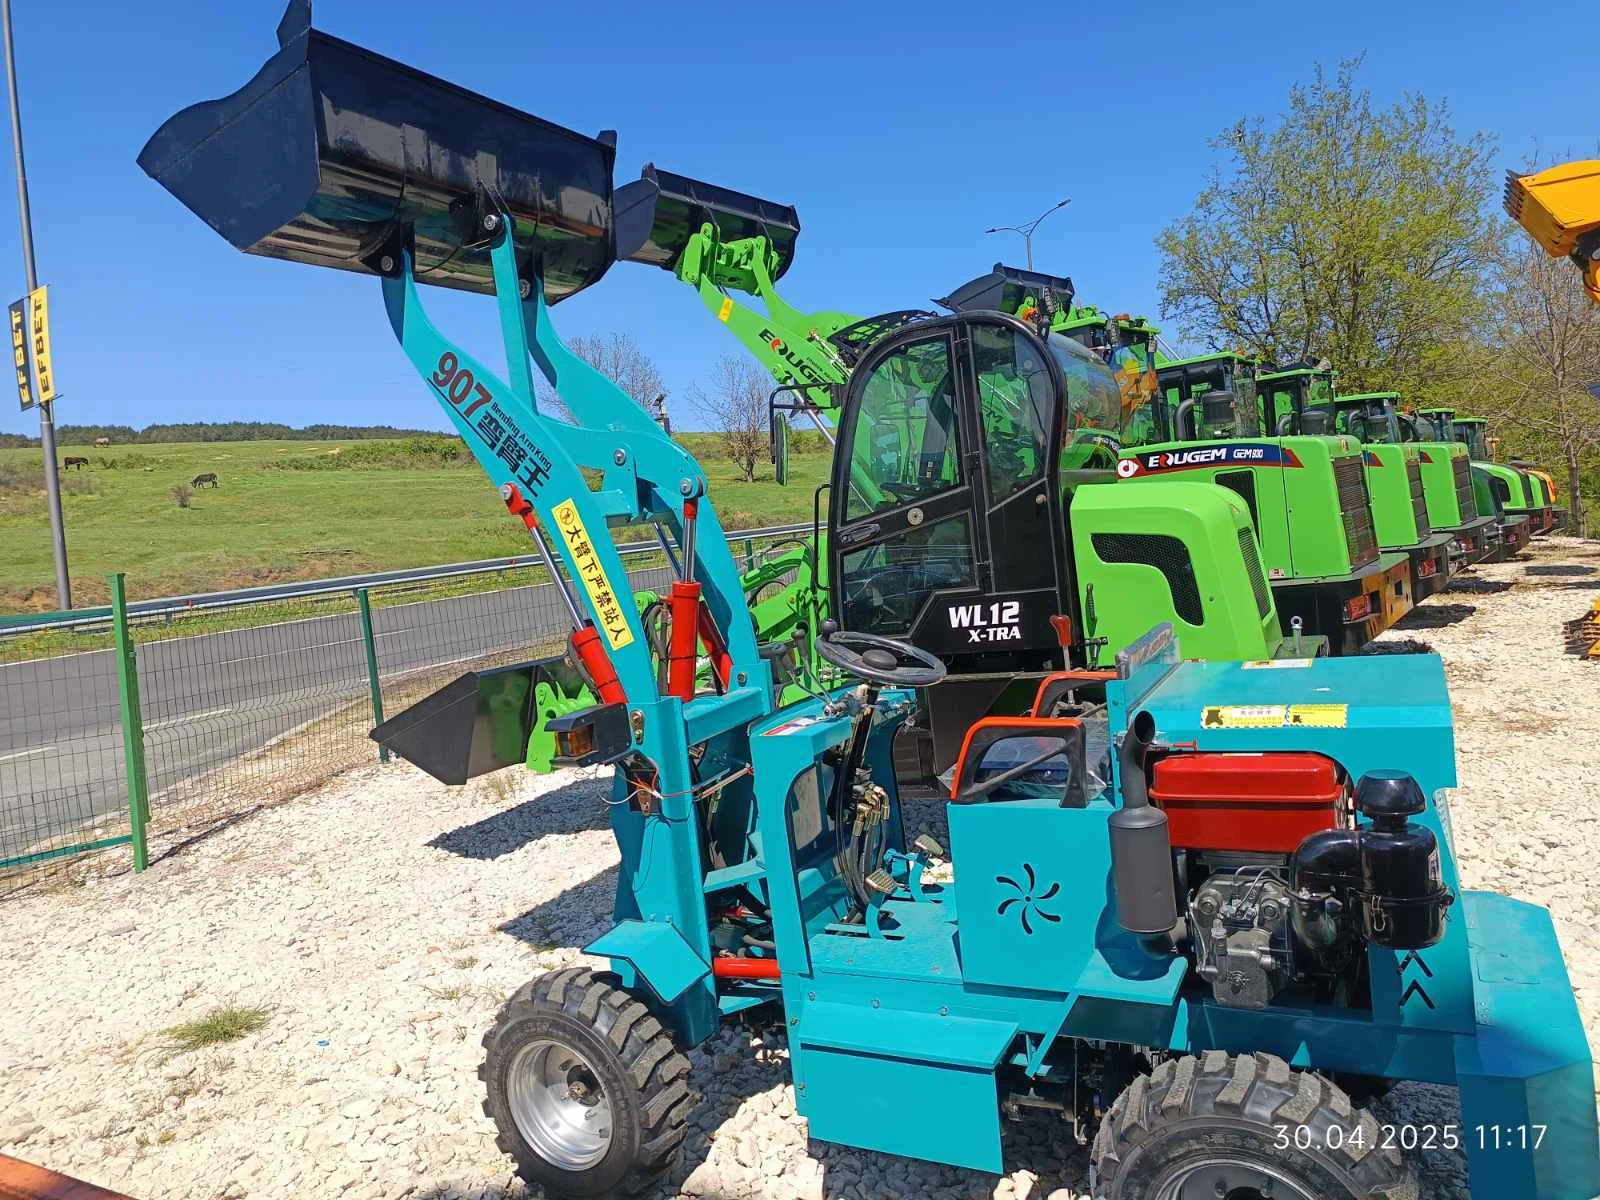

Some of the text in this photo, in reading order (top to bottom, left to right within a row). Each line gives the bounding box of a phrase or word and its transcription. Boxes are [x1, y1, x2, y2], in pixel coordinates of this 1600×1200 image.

[34, 298, 50, 393] EFBET
[432, 351, 493, 418] 907
[491, 402, 520, 438] Bending
[566, 525, 626, 642] 大臂下严禁站人
[948, 601, 1020, 629] WL12
[967, 625, 1022, 643] X-TRA
